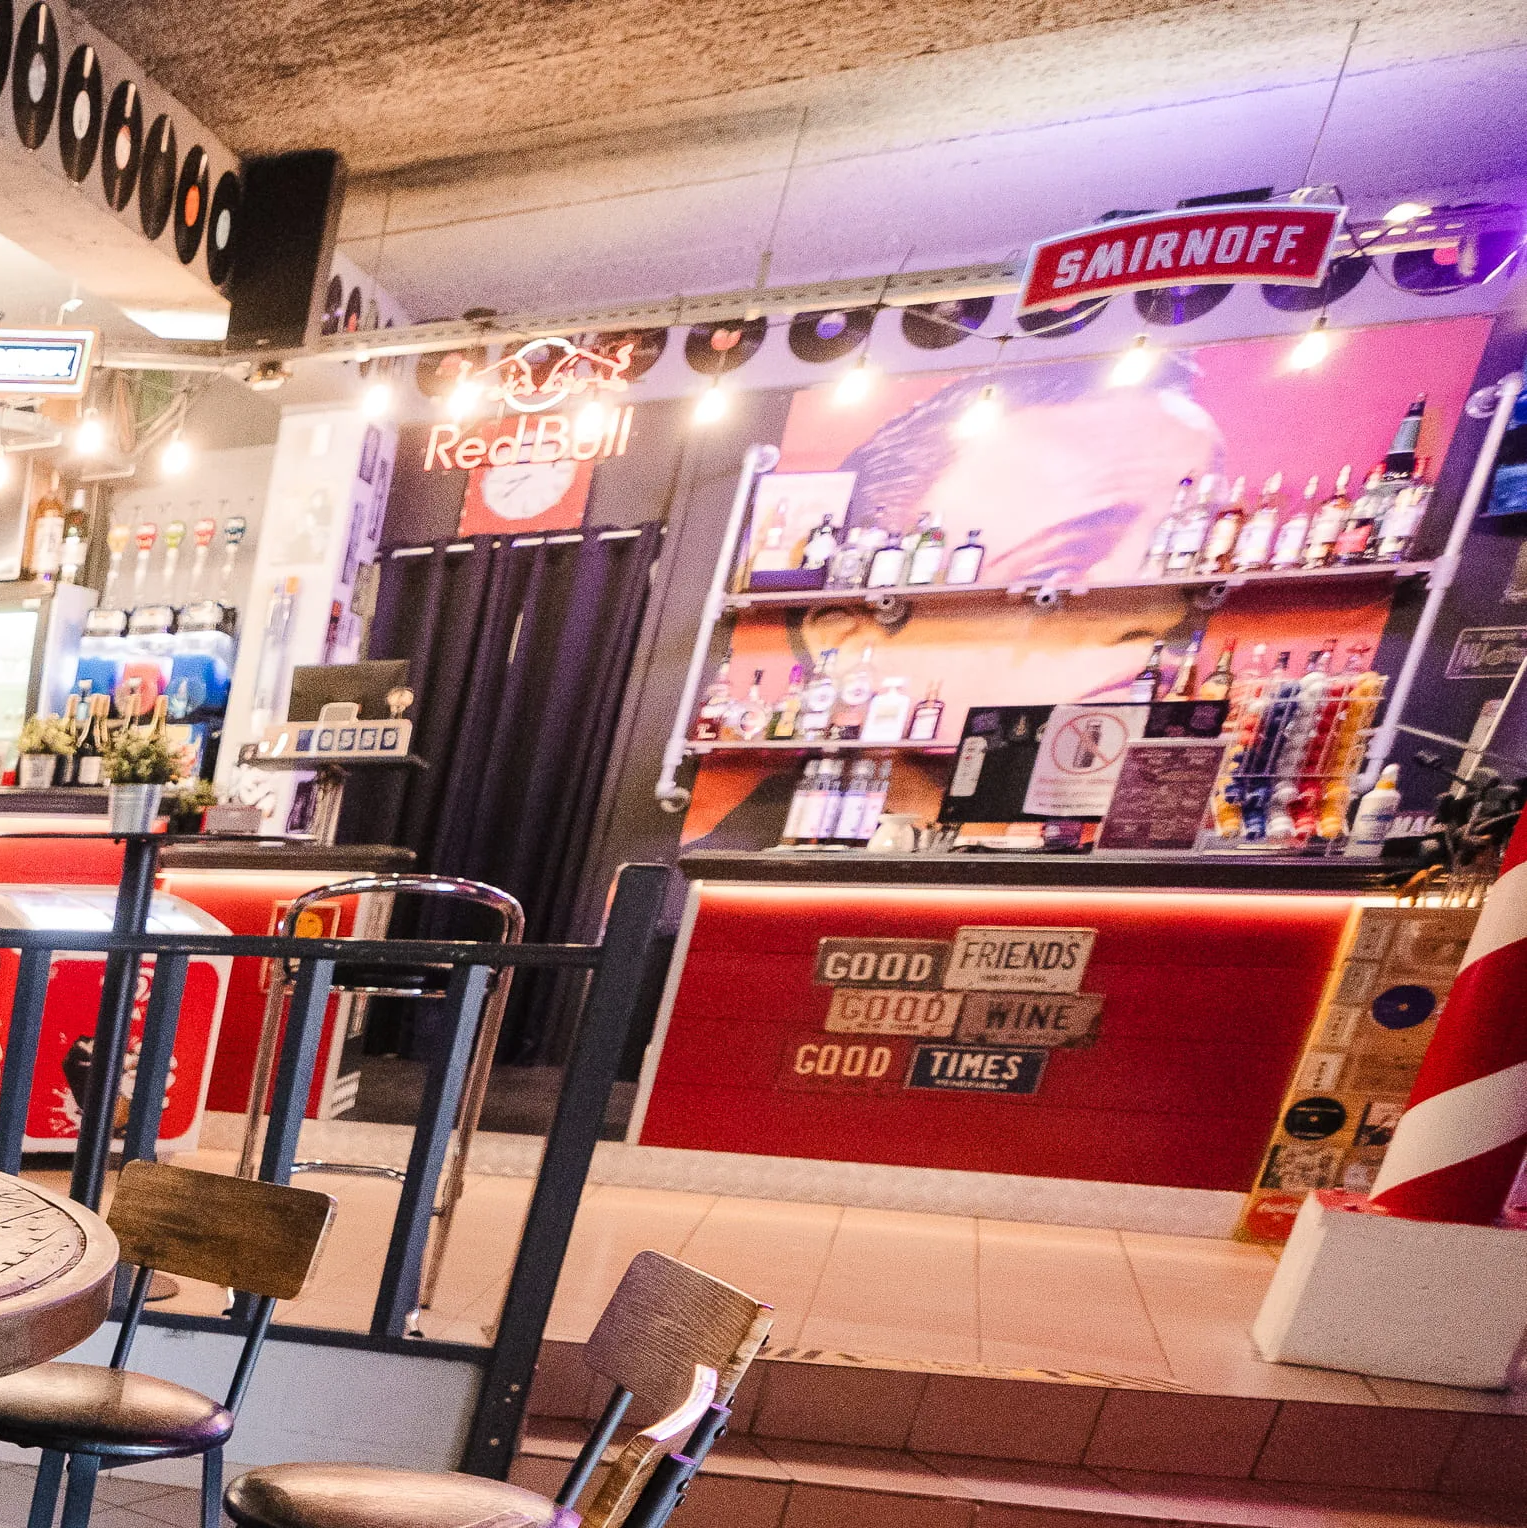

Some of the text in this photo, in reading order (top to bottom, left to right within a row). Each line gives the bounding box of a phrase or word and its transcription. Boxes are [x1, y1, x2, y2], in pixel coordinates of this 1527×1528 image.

[1052, 225, 1304, 289] SMIRNOFF
[424, 405, 634, 471] Red Bull
[824, 950, 933, 982] GOOD
[958, 940, 1080, 971] FRIENDS
[839, 996, 1074, 1031] GOOD WINE
[794, 1043, 1023, 1081] GOOD TIMES
